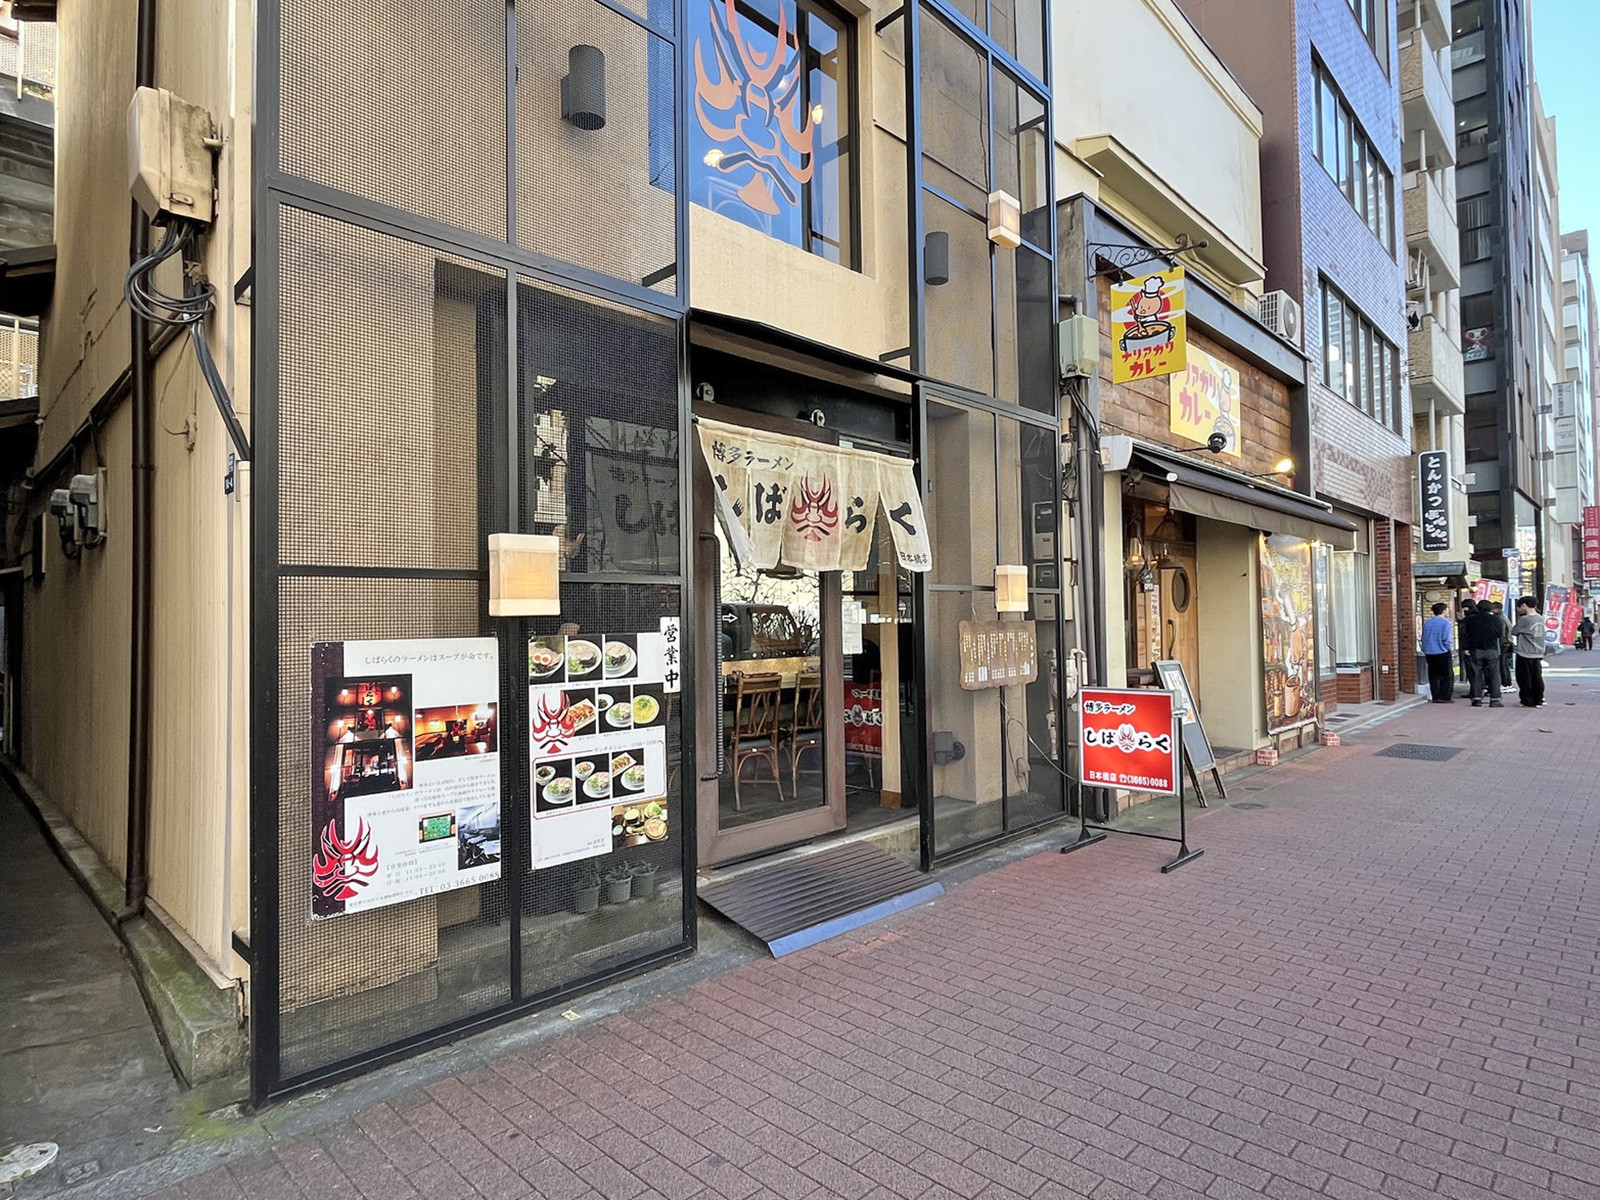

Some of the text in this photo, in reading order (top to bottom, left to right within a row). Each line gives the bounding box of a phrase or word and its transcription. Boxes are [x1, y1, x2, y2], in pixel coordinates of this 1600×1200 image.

[1129, 358, 1167, 378] カレー
[1179, 387, 1211, 425] カレー
[711, 440, 795, 471] 博多ラーメン
[1427, 456, 1443, 507] とんかつ
[1425, 509, 1448, 539] ぼんとん
[365, 652, 494, 665] しばらくのラーメンはスープが命です。
[663, 623, 679, 689] 営業中
[1085, 701, 1136, 715] 博多ラーメン
[1089, 770, 1117, 783] 日本橋店
